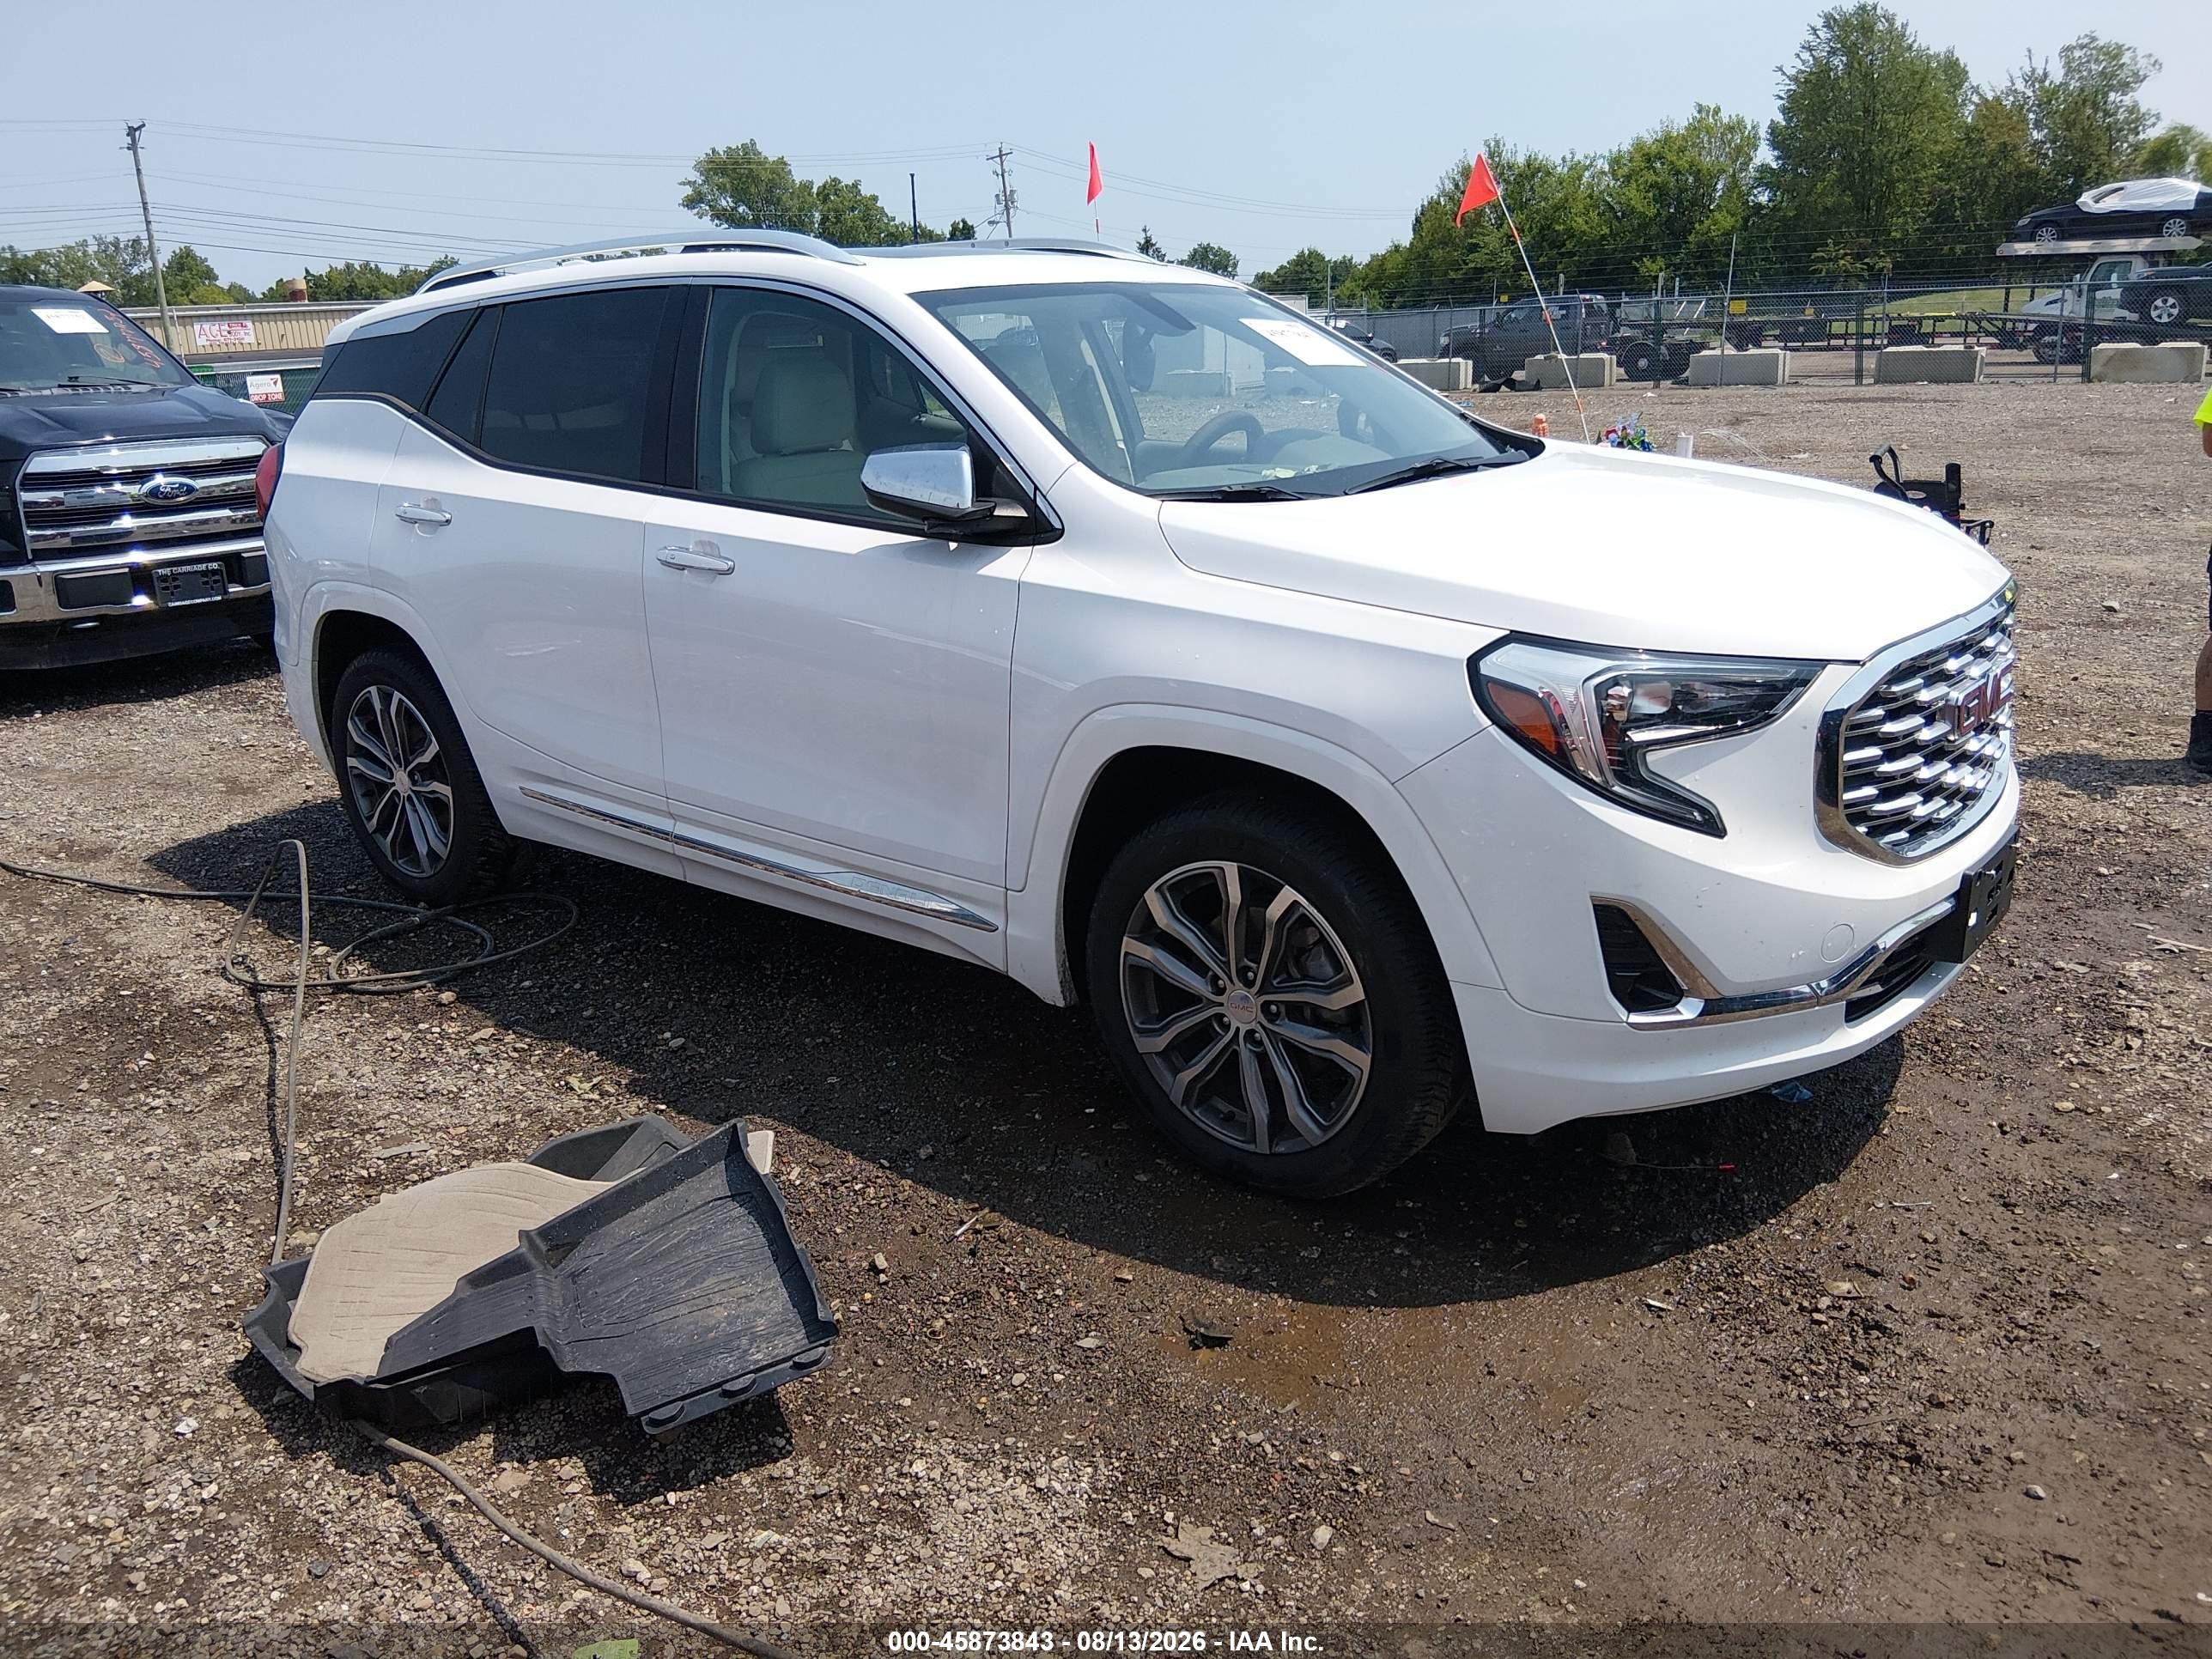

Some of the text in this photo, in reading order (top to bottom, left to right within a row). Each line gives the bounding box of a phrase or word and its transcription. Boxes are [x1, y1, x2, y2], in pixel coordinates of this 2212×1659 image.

[198, 323, 228, 338] ACE
[251, 392, 283, 402] DROP ZONE
[158, 483, 187, 498] Ford
[173, 564, 207, 574] CARRIAGE
[1959, 658, 2014, 736] GMC
[1230, 1002, 1254, 1013] GMC
